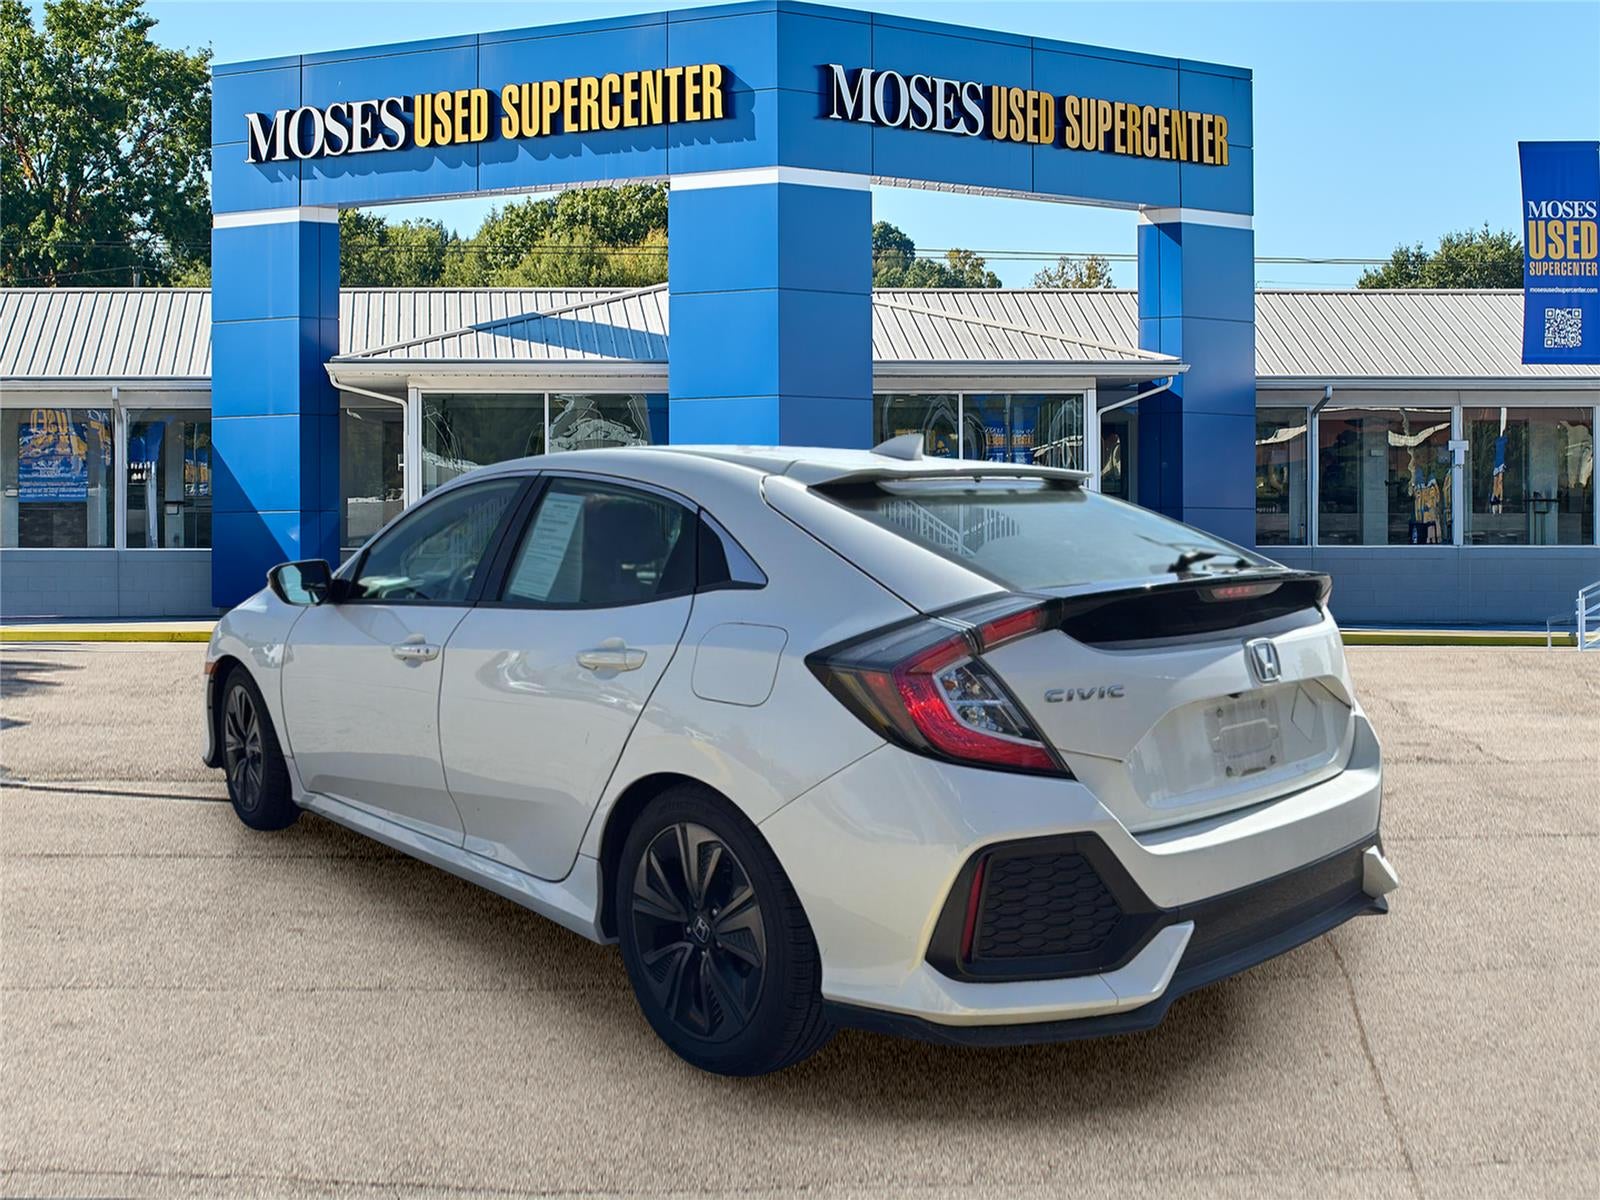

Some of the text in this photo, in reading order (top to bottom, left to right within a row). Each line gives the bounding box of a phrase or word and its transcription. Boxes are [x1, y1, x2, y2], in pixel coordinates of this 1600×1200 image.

[245, 63, 724, 163] MOSES USED SUPERCENTER
[828, 63, 1229, 166] MOSES USED SUPERCENTER
[1528, 200, 1597, 219] MOSES
[1528, 220, 1598, 260] USED
[1529, 261, 1598, 276] SUPERCENTER
[1044, 684, 1125, 704] CIVIC
